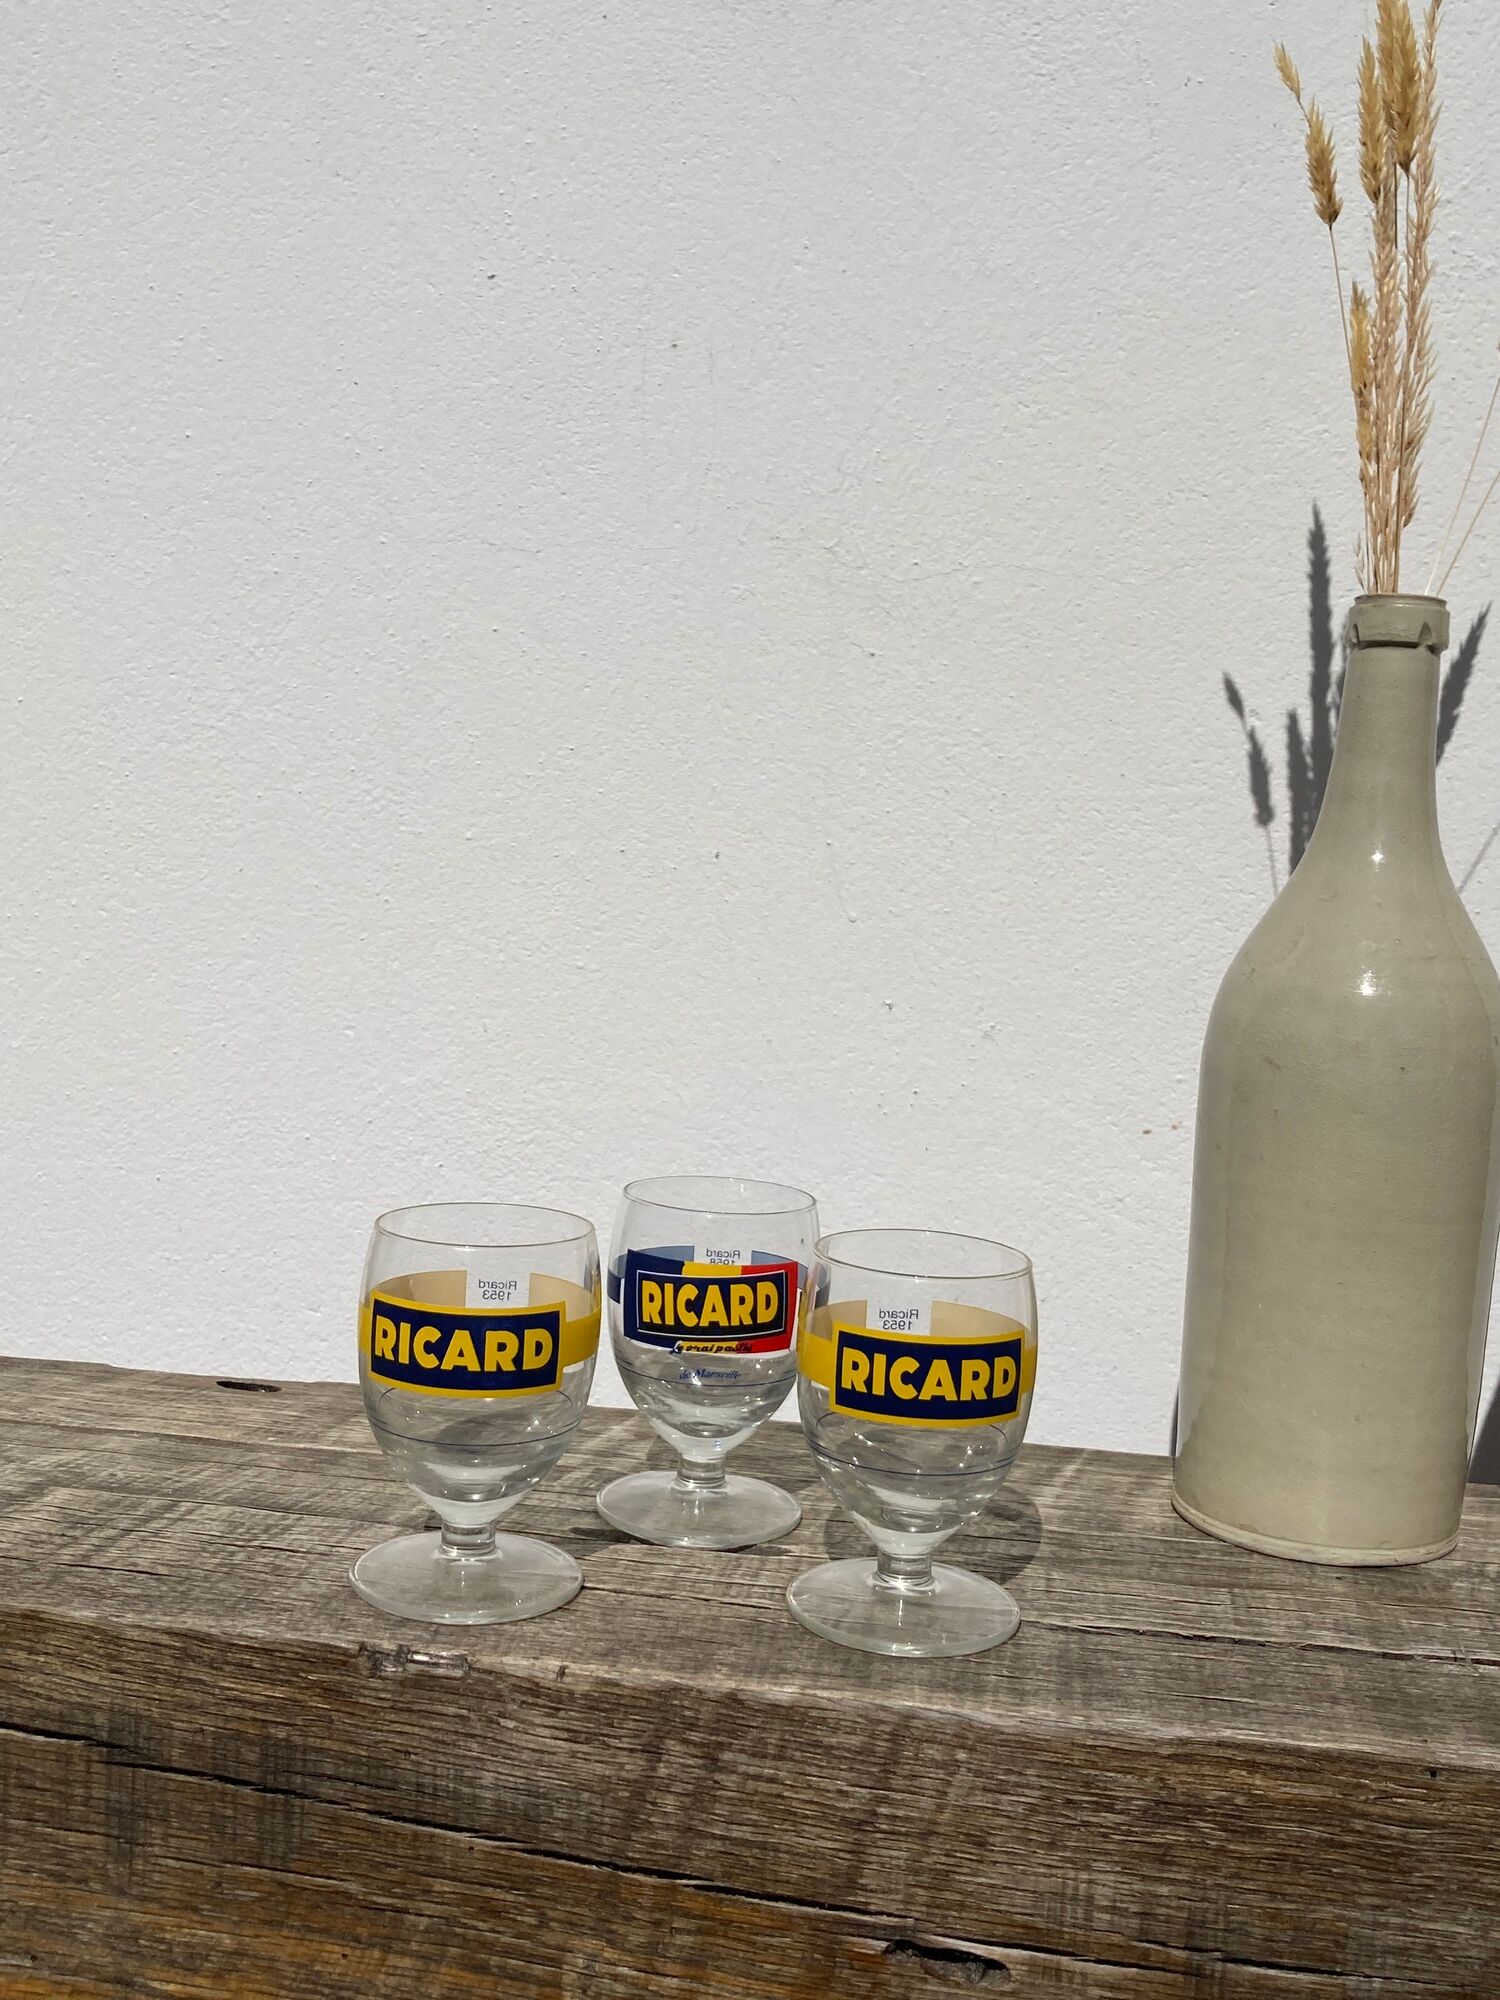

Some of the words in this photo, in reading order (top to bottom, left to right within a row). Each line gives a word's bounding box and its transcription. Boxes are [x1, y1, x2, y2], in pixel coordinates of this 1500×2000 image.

[641, 1280, 779, 1328] RICARD
[374, 1314, 554, 1372] RICARD
[680, 1369, 690, 1379] de
[694, 1368, 741, 1379] Marseille
[840, 1346, 1018, 1401] RICARD
